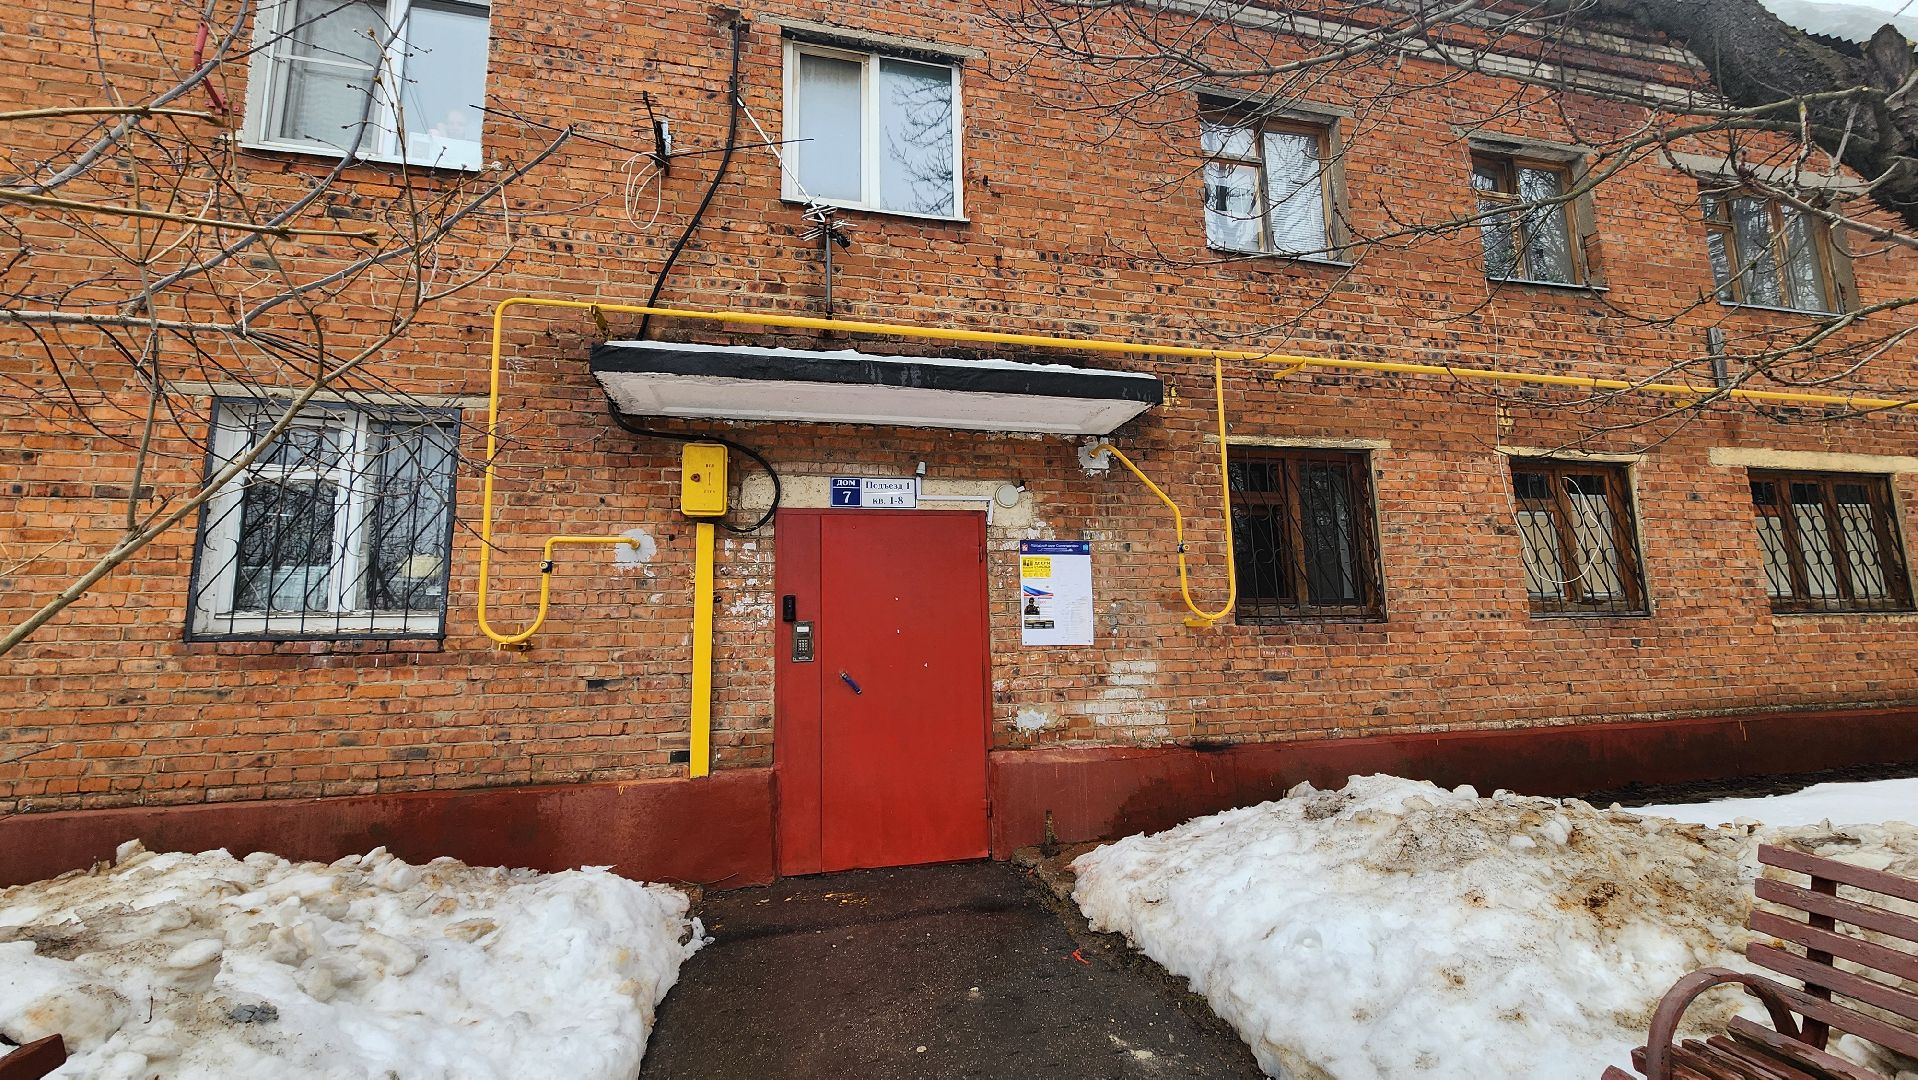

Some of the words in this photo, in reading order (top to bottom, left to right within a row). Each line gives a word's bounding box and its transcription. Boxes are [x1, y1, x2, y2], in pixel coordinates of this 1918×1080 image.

[865, 481, 903, 490] Подъезд
[906, 482, 910, 490] 1
[842, 490, 852, 504] 7
[890, 496, 904, 505] 1-8
